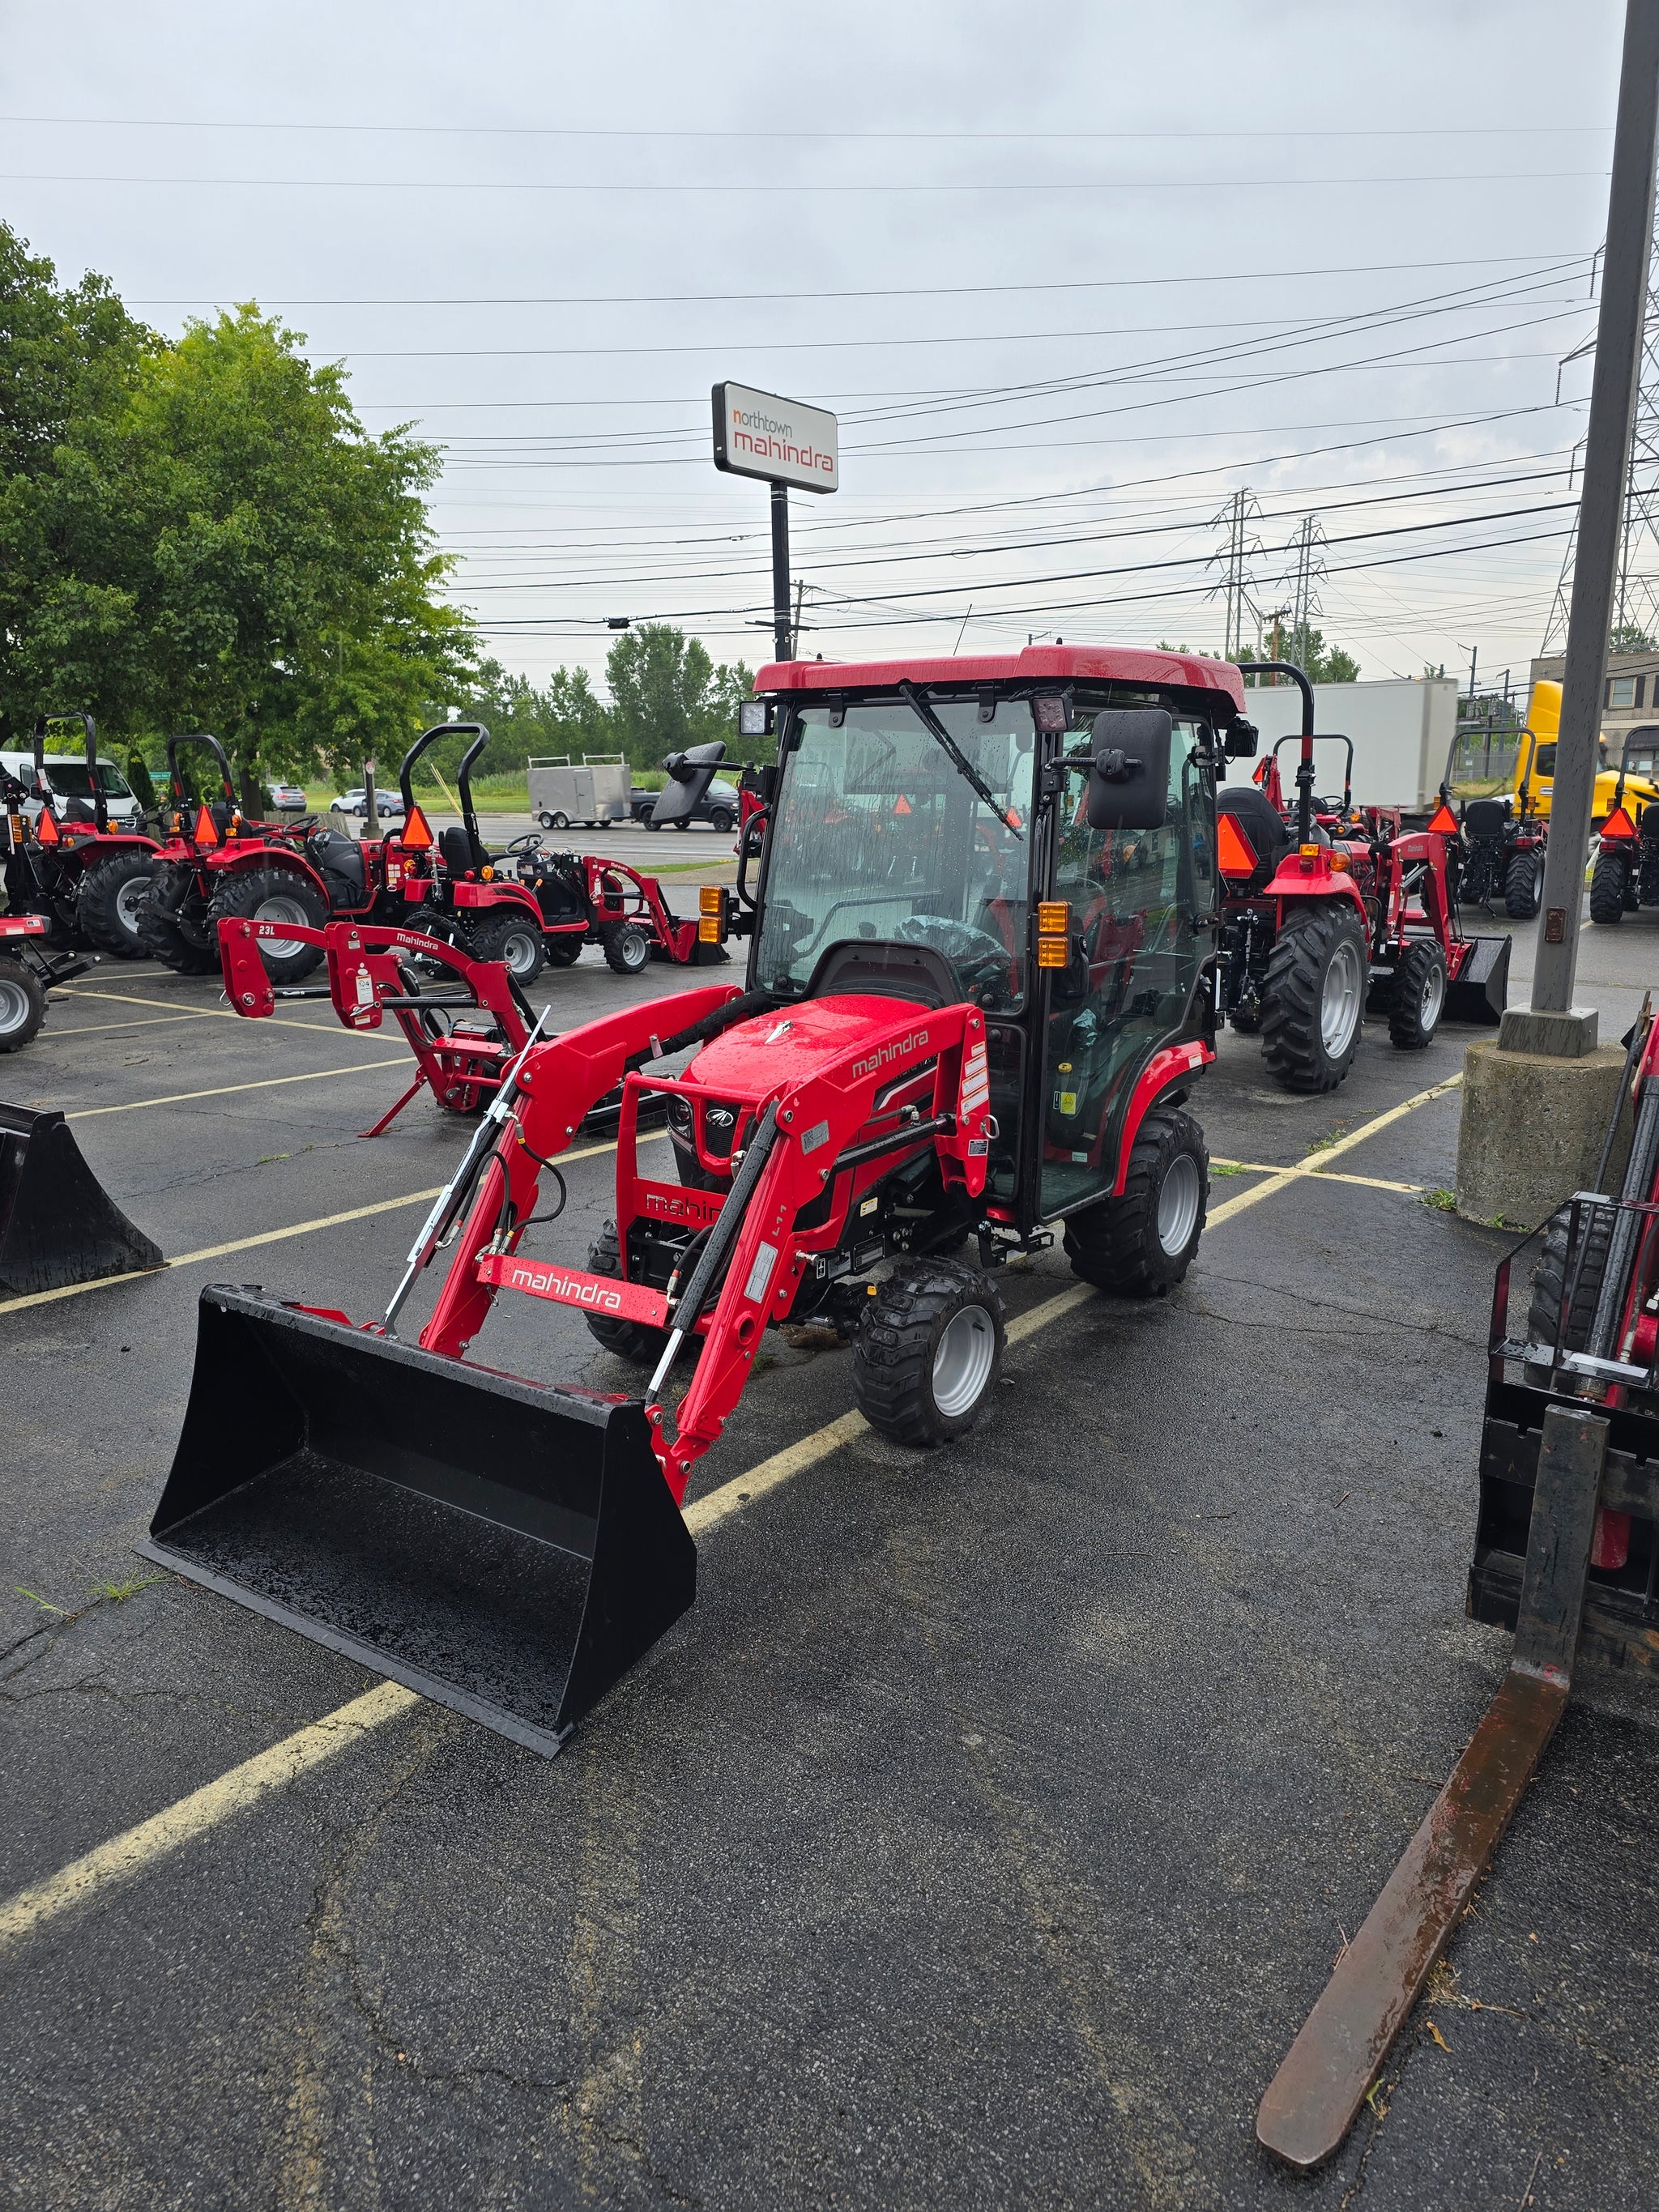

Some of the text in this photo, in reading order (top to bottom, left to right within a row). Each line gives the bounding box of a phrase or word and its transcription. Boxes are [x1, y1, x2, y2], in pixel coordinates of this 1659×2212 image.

[733, 409, 792, 438] northtown
[734, 432, 834, 472] mahindra
[258, 925, 275, 936] 23L
[396, 932, 439, 950] Mahindra
[852, 1030, 929, 1079] mahindra
[646, 1194, 723, 1221] mahin
[511, 1269, 621, 1309] mahindra
